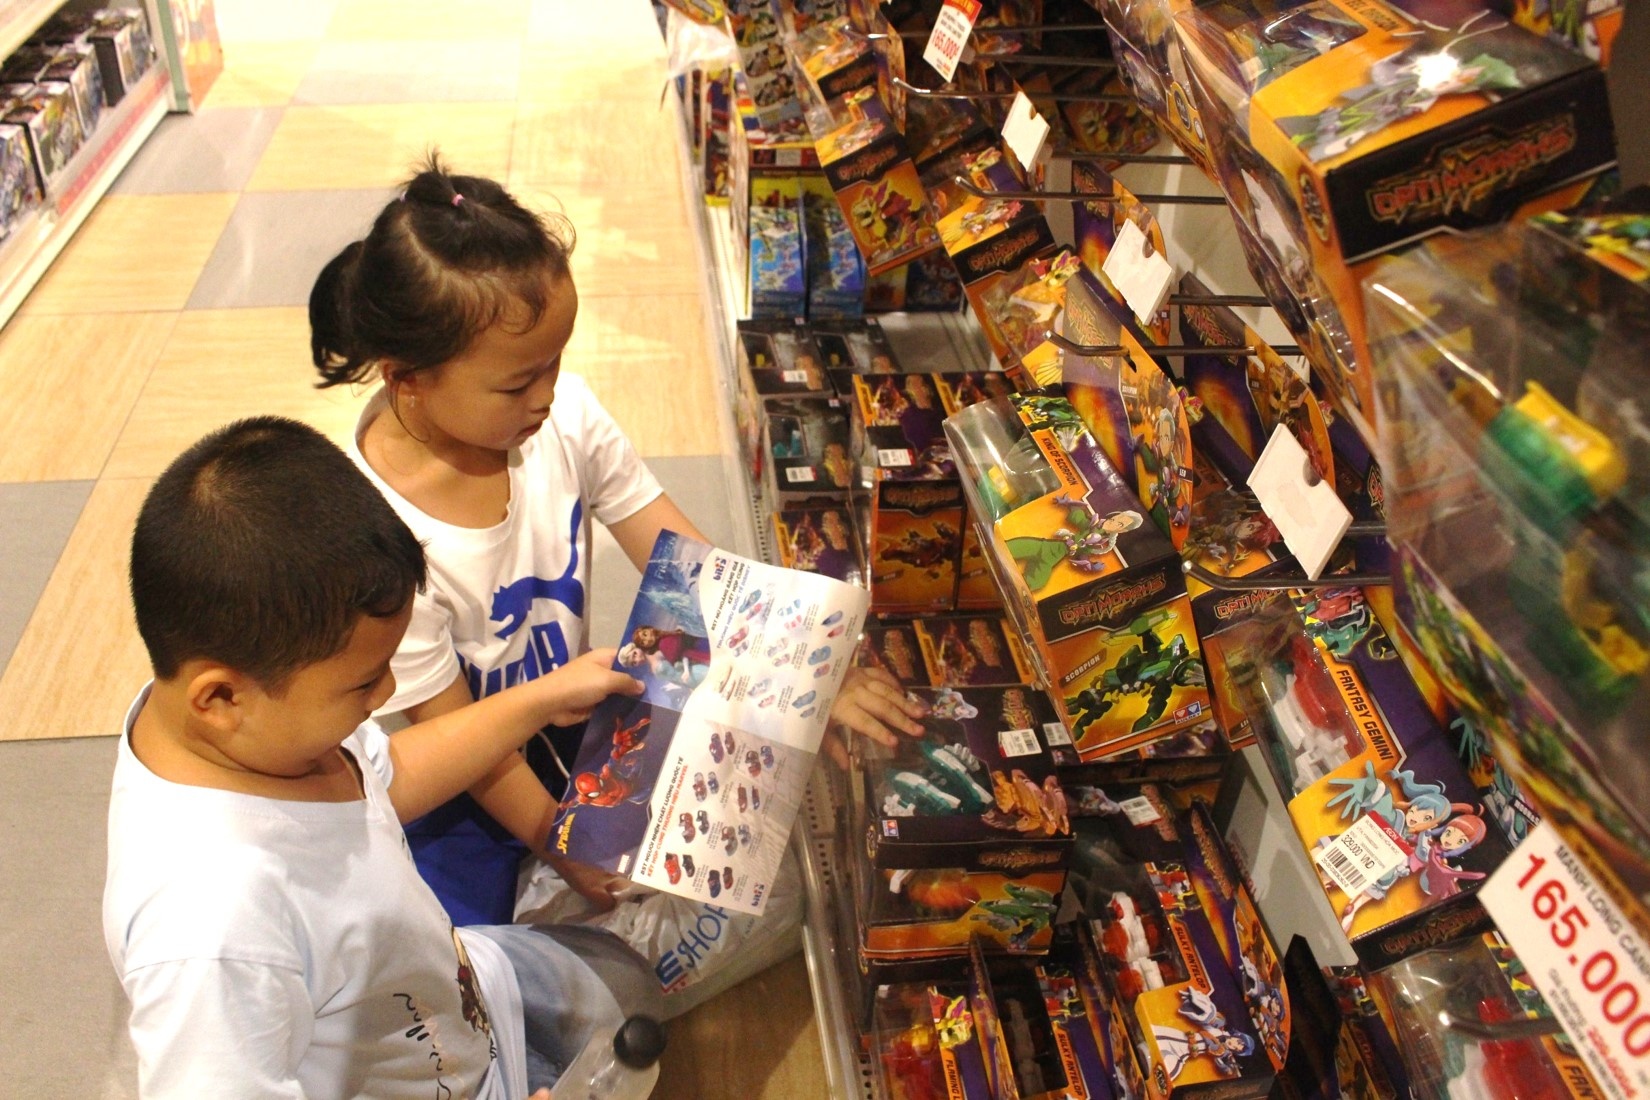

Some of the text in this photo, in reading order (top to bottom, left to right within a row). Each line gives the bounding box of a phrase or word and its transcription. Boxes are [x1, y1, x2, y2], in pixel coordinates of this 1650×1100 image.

[1041, 435, 1078, 486] KING OF SCORPION
[1060, 599, 1099, 624] OPTI
[1064, 653, 1100, 682] SCORPION
[1335, 667, 1394, 762] FANTASY GEMINI
[1359, 853, 1375, 870] VND
[1174, 924, 1206, 991] SULKY ANTELOP
[1517, 851, 1650, 1058] 165.000
[945, 1057, 959, 1094] FLAMING
[1058, 1031, 1080, 1097] SULKY ANTELOP
